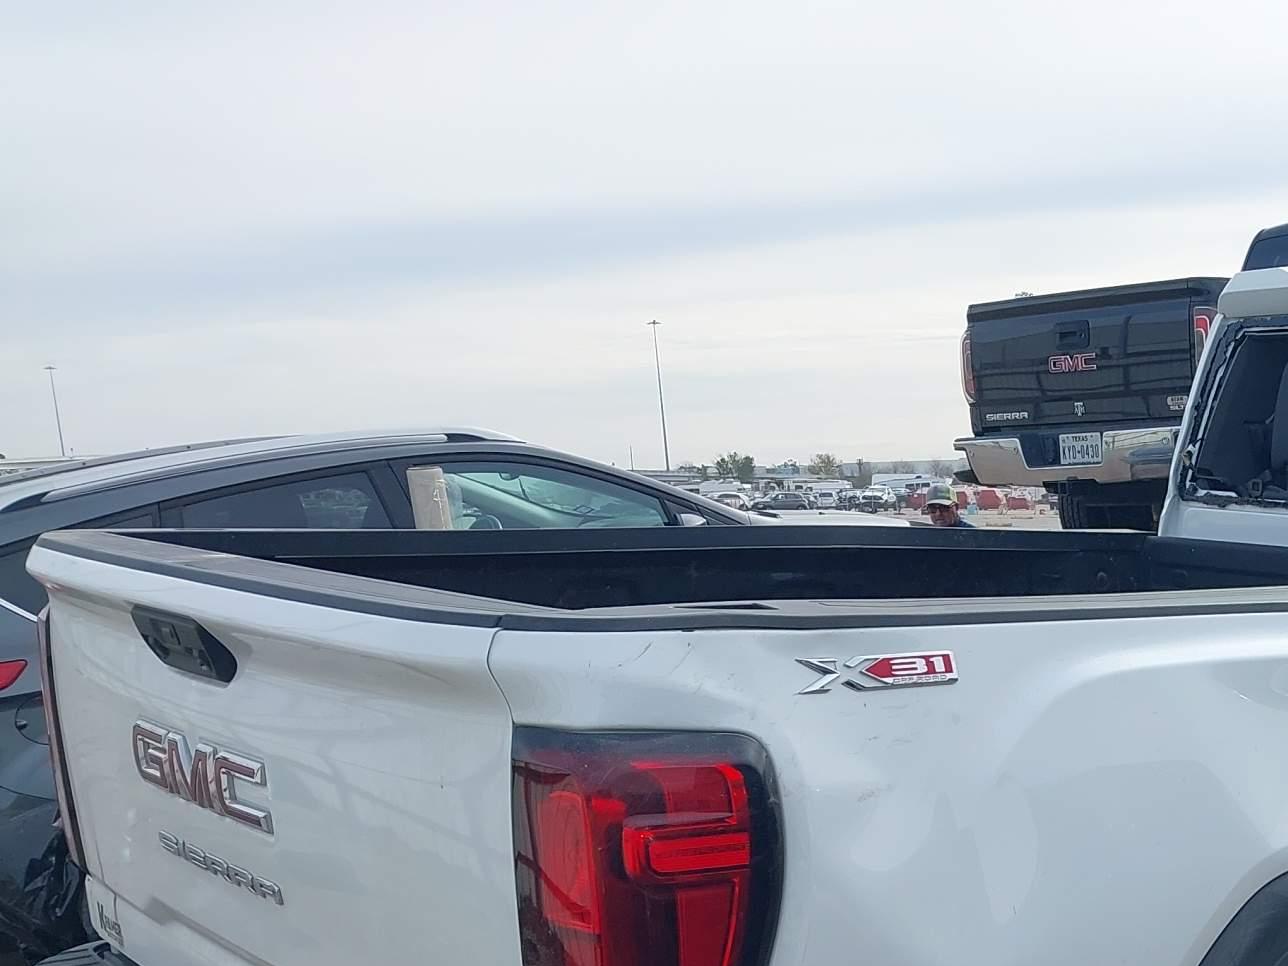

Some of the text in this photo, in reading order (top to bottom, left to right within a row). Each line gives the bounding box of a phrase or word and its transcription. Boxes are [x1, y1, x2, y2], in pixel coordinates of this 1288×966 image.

[1048, 352, 1097, 374] GMC
[985, 411, 1029, 421] SIERRA
[1071, 435, 1089, 443] TEXAS
[132, 719, 275, 837] GMC
[158, 829, 284, 906] SIERRA
